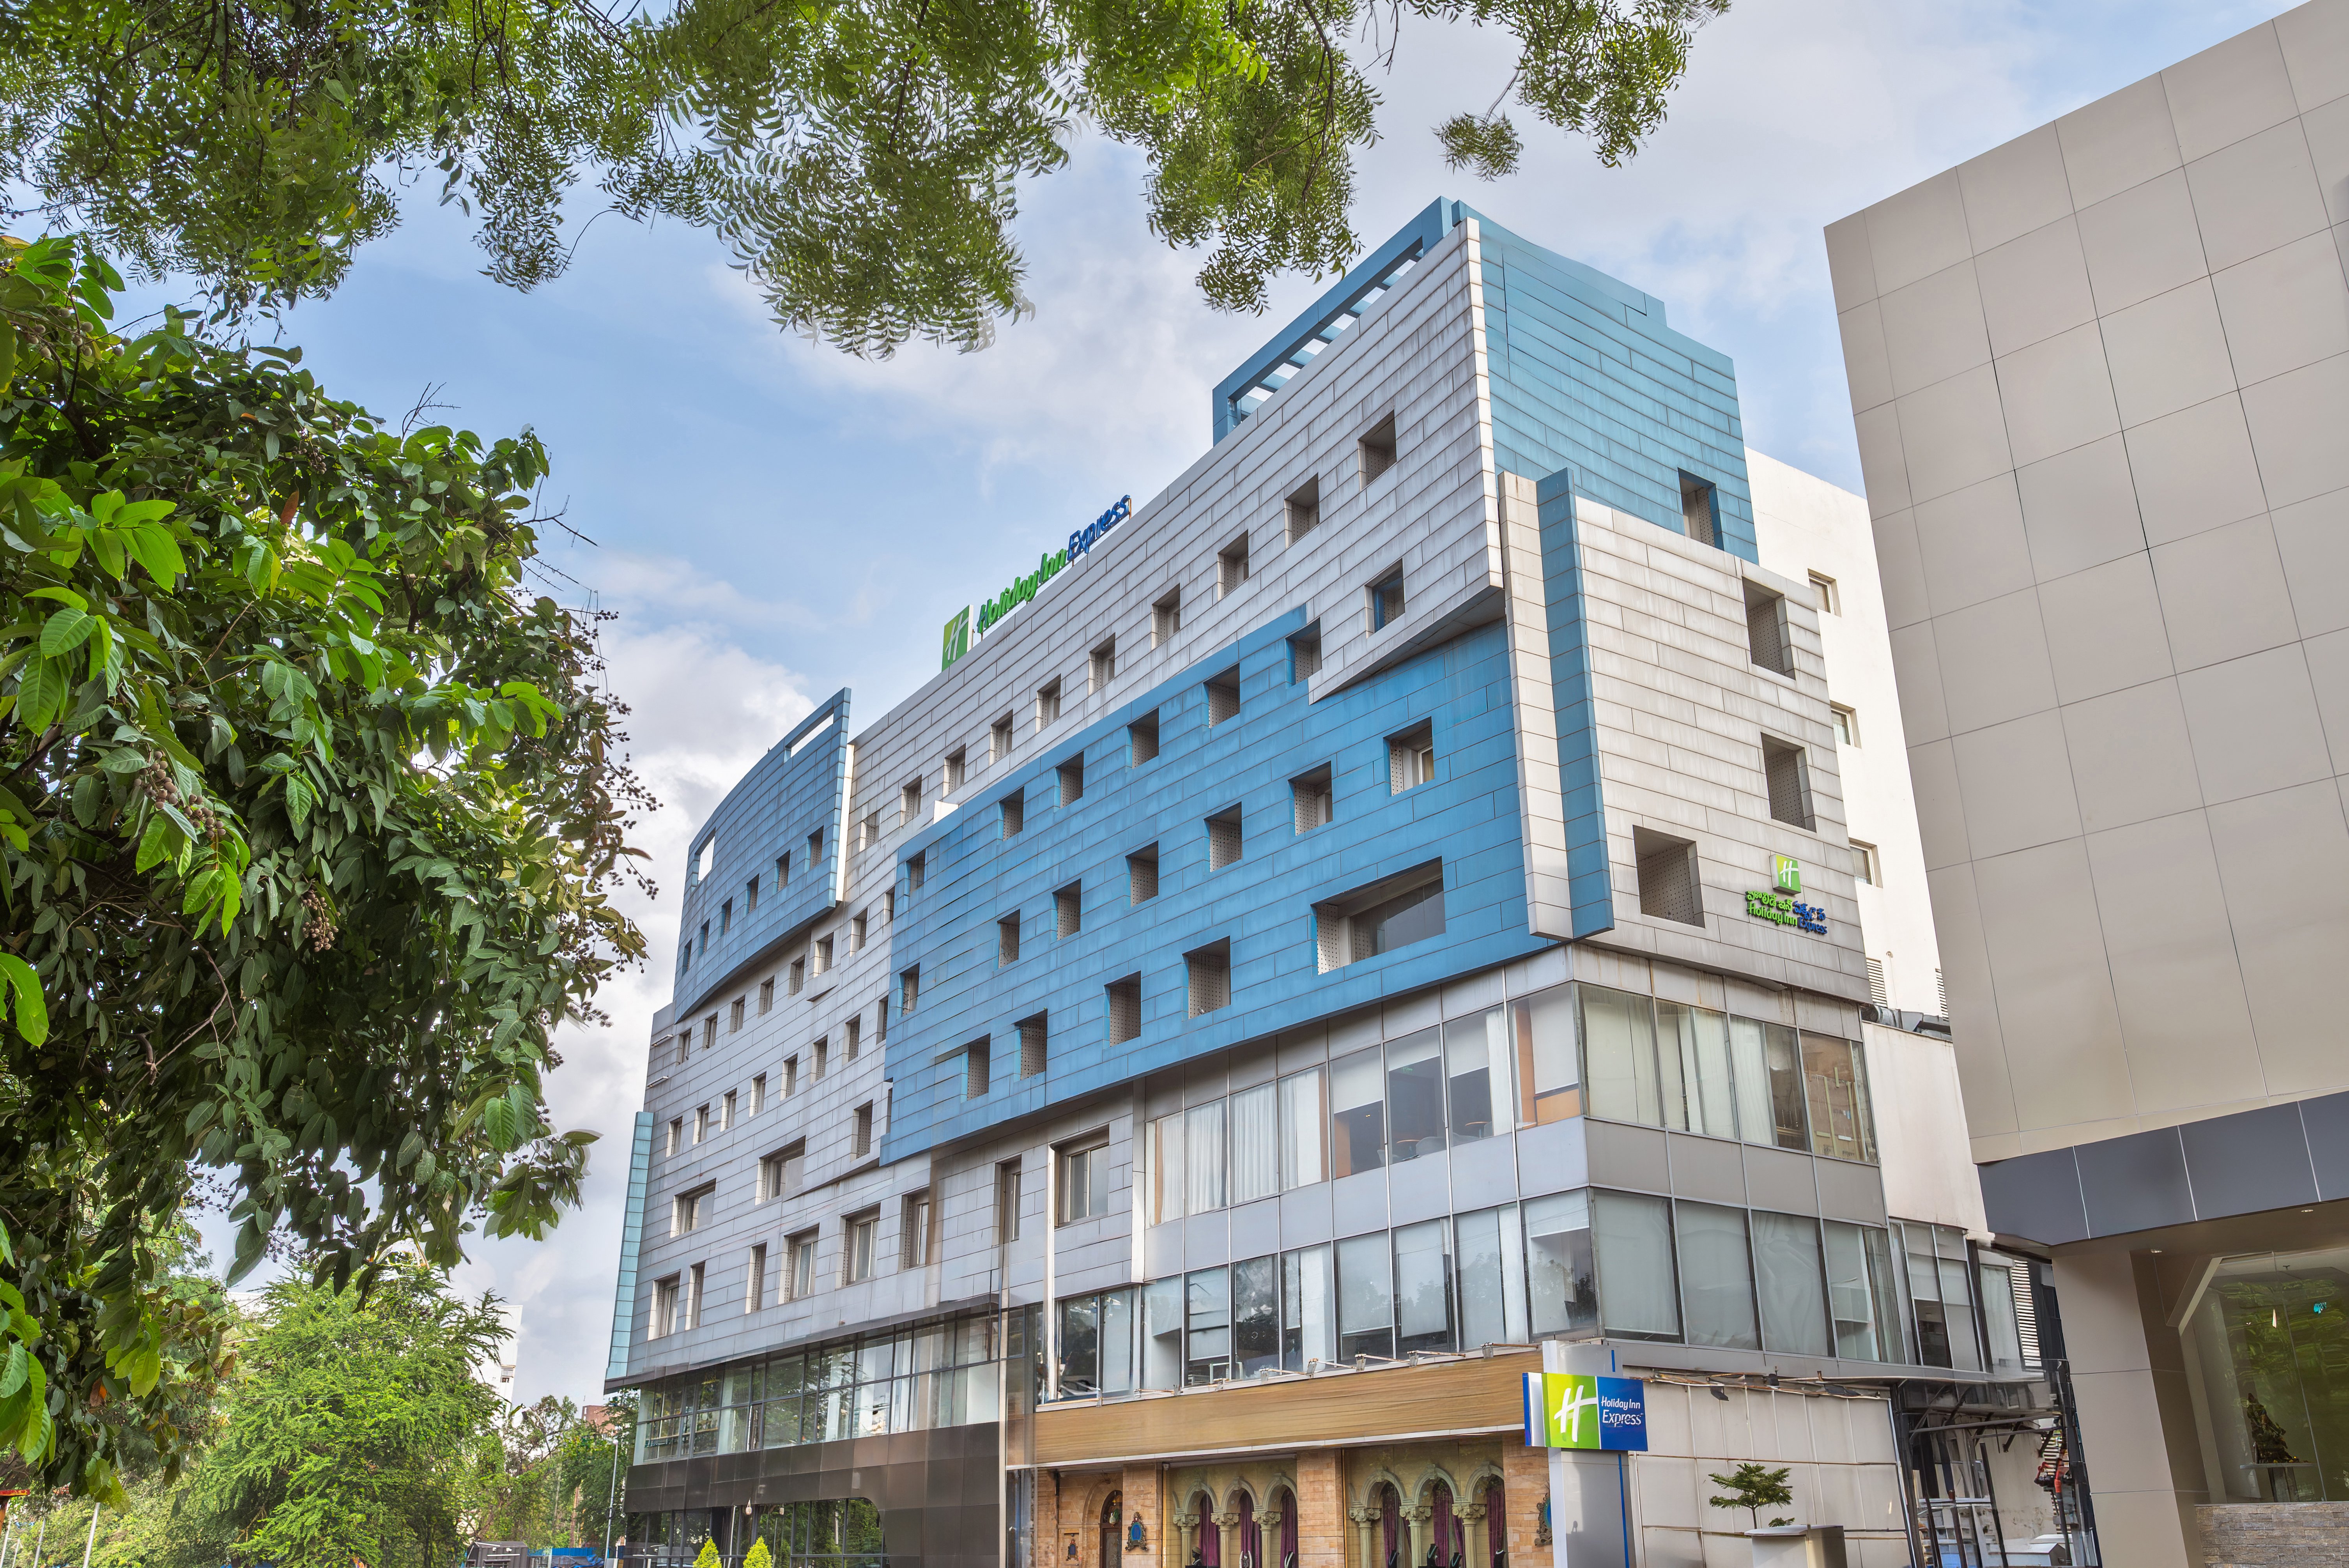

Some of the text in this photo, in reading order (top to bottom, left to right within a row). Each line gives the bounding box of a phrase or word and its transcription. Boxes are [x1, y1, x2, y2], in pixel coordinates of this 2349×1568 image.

[977, 495, 1130, 634] Holiday Inn Express
[1747, 902, 1828, 935] Holiday Inn Express
[1601, 1396, 1641, 1410] Holiday Inn
[1602, 1409, 1641, 1427] Express
